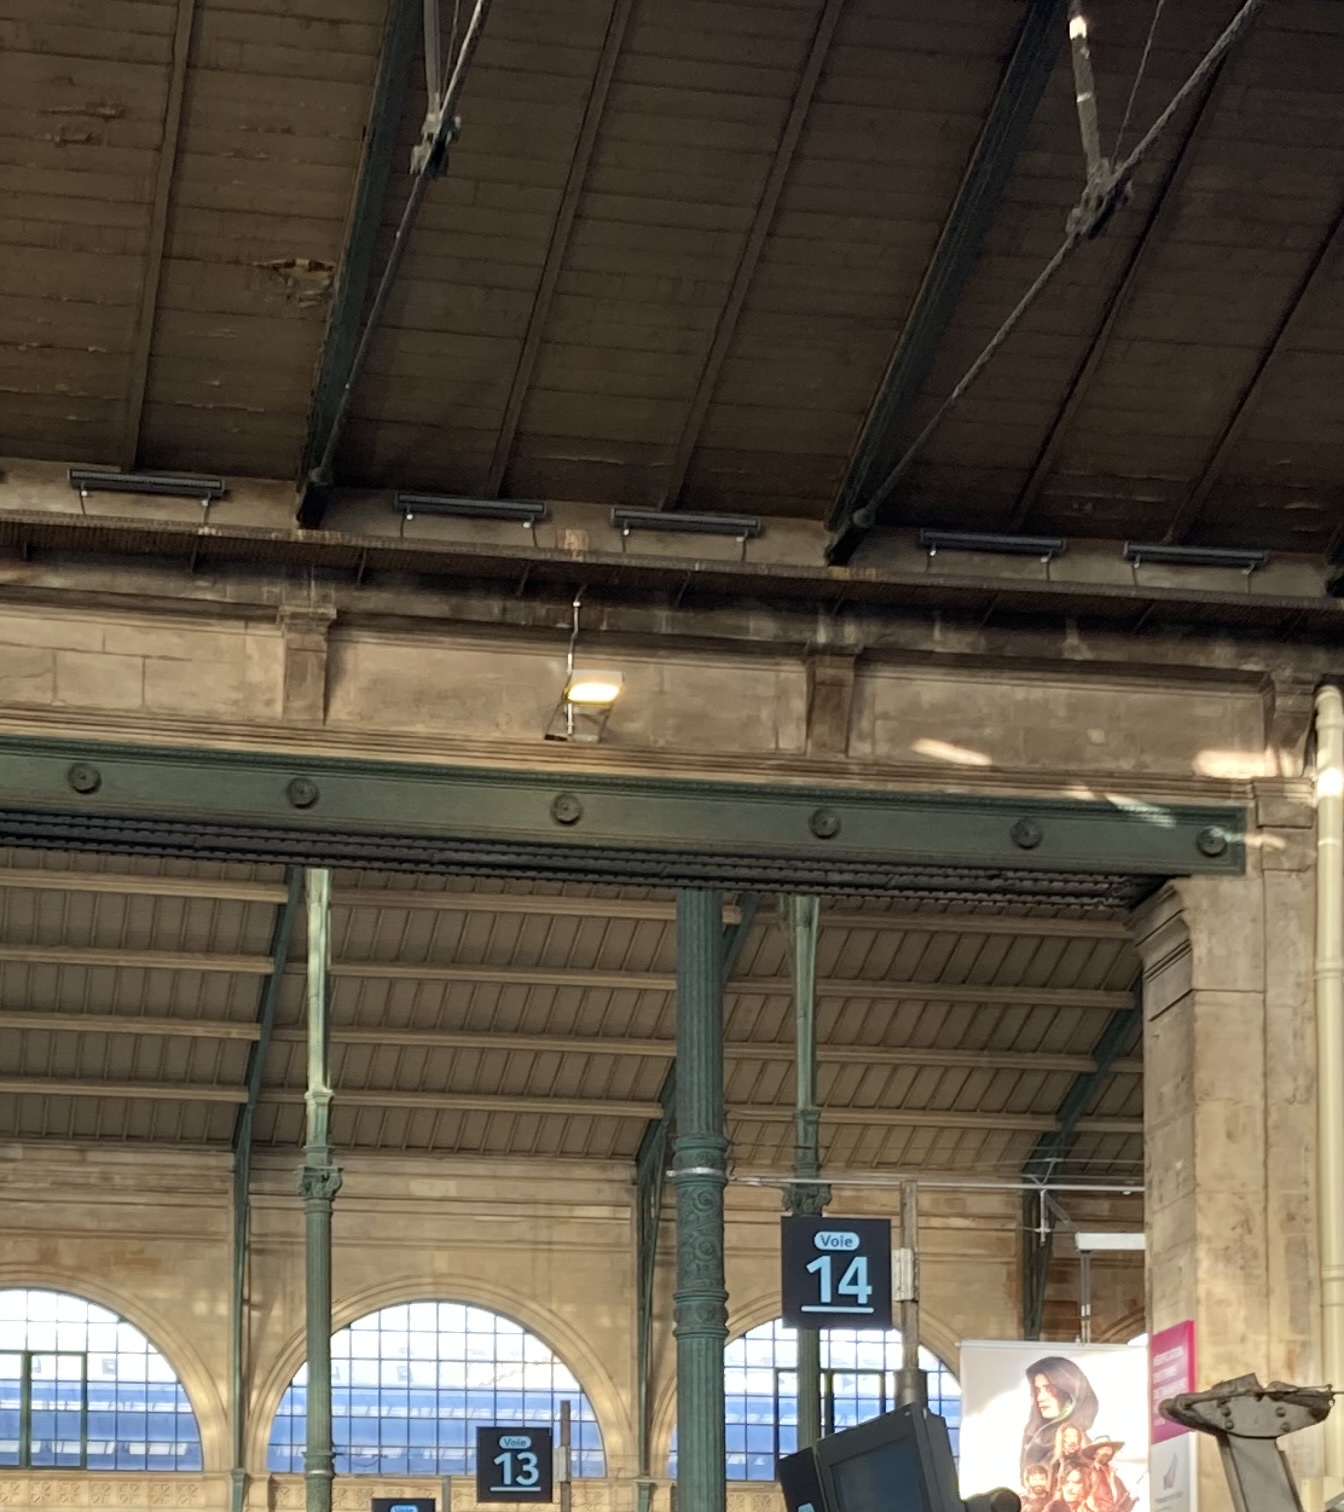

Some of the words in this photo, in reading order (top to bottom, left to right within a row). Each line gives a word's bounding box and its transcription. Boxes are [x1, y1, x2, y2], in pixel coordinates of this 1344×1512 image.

[820, 1234, 853, 1249] Voie
[806, 1255, 873, 1305] 14
[502, 1436, 527, 1449] Voie
[493, 1452, 540, 1487] 13
